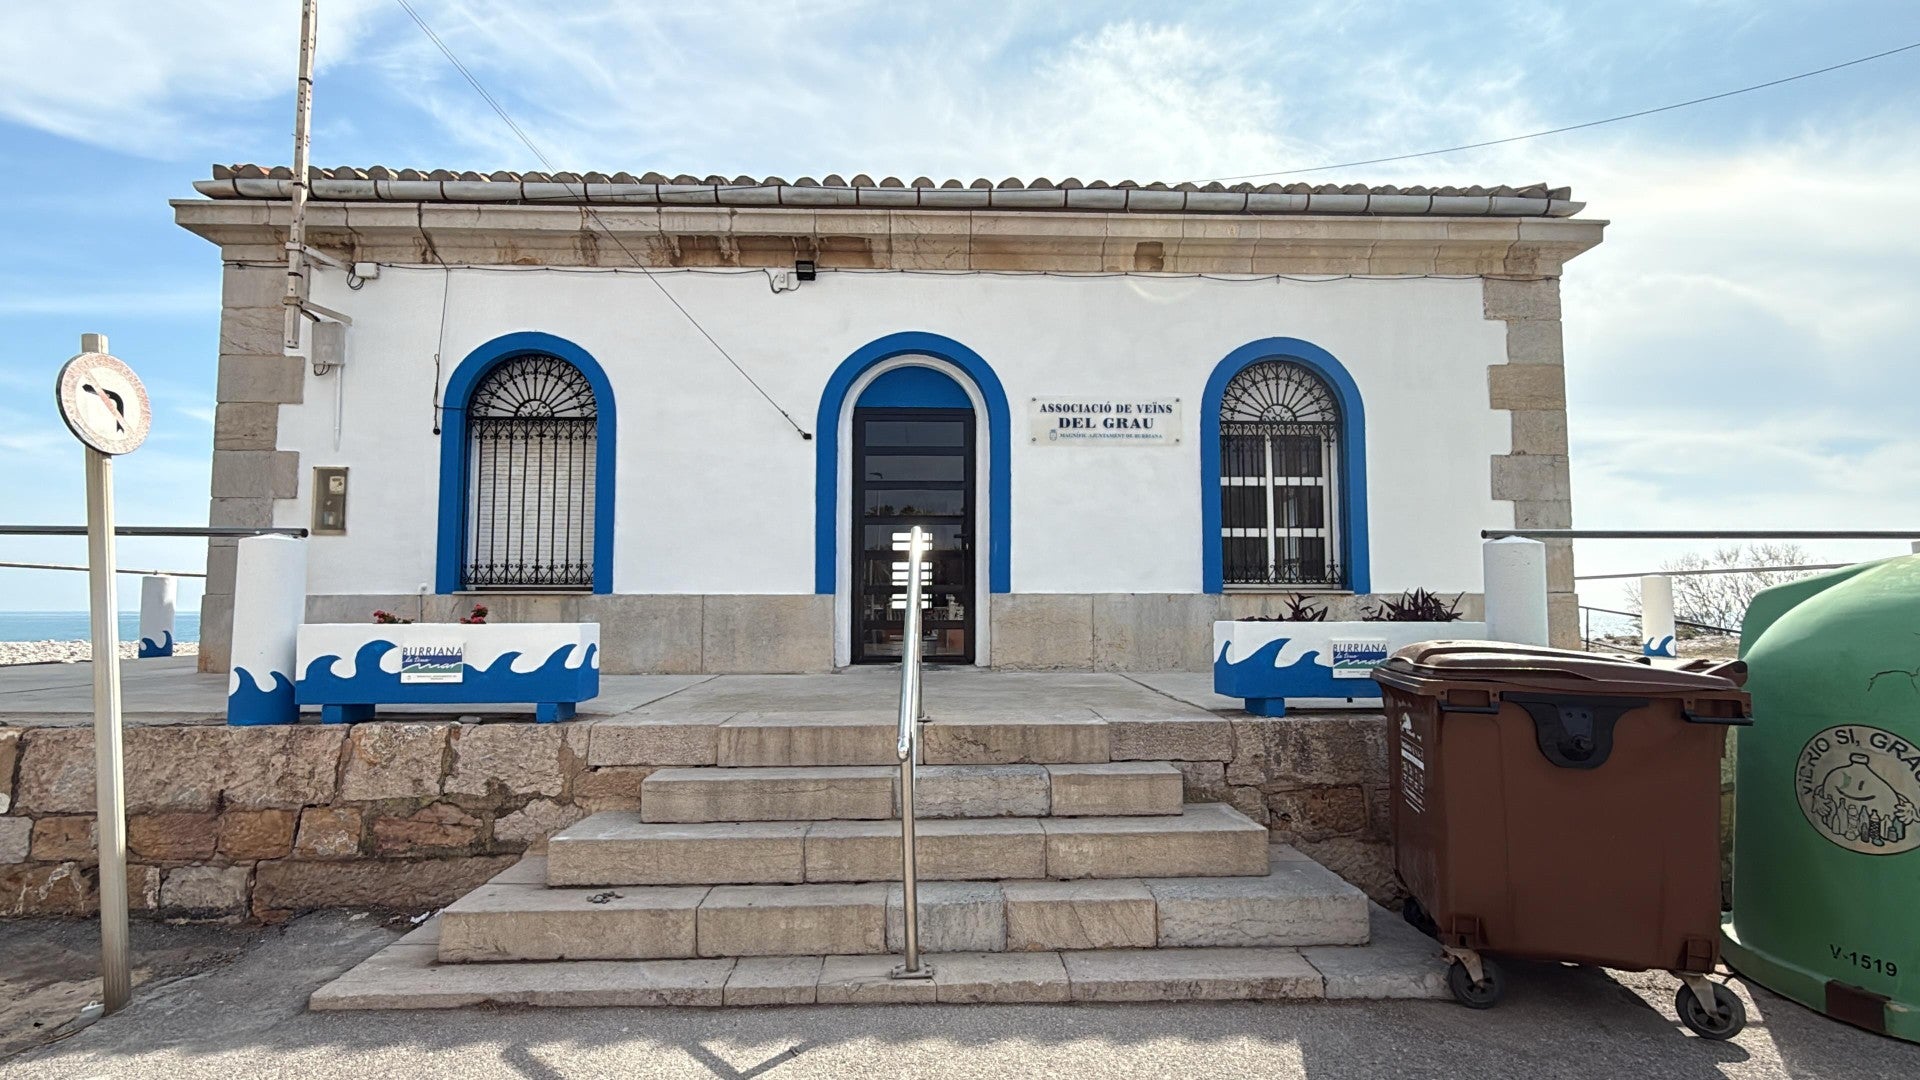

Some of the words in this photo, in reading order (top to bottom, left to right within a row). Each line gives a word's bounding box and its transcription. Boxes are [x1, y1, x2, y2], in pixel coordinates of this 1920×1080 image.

[1040, 401, 1112, 413] ASSOCIACIÓ
[1116, 404, 1132, 413] DE
[1137, 402, 1173, 414] VEÏNS
[1058, 417, 1096, 429] DEL
[1102, 417, 1154, 429] GRAU
[402, 646, 462, 655] BURRIANA
[1333, 643, 1387, 652] BURRIANA
[1829, 943, 1898, 977] V-1519
